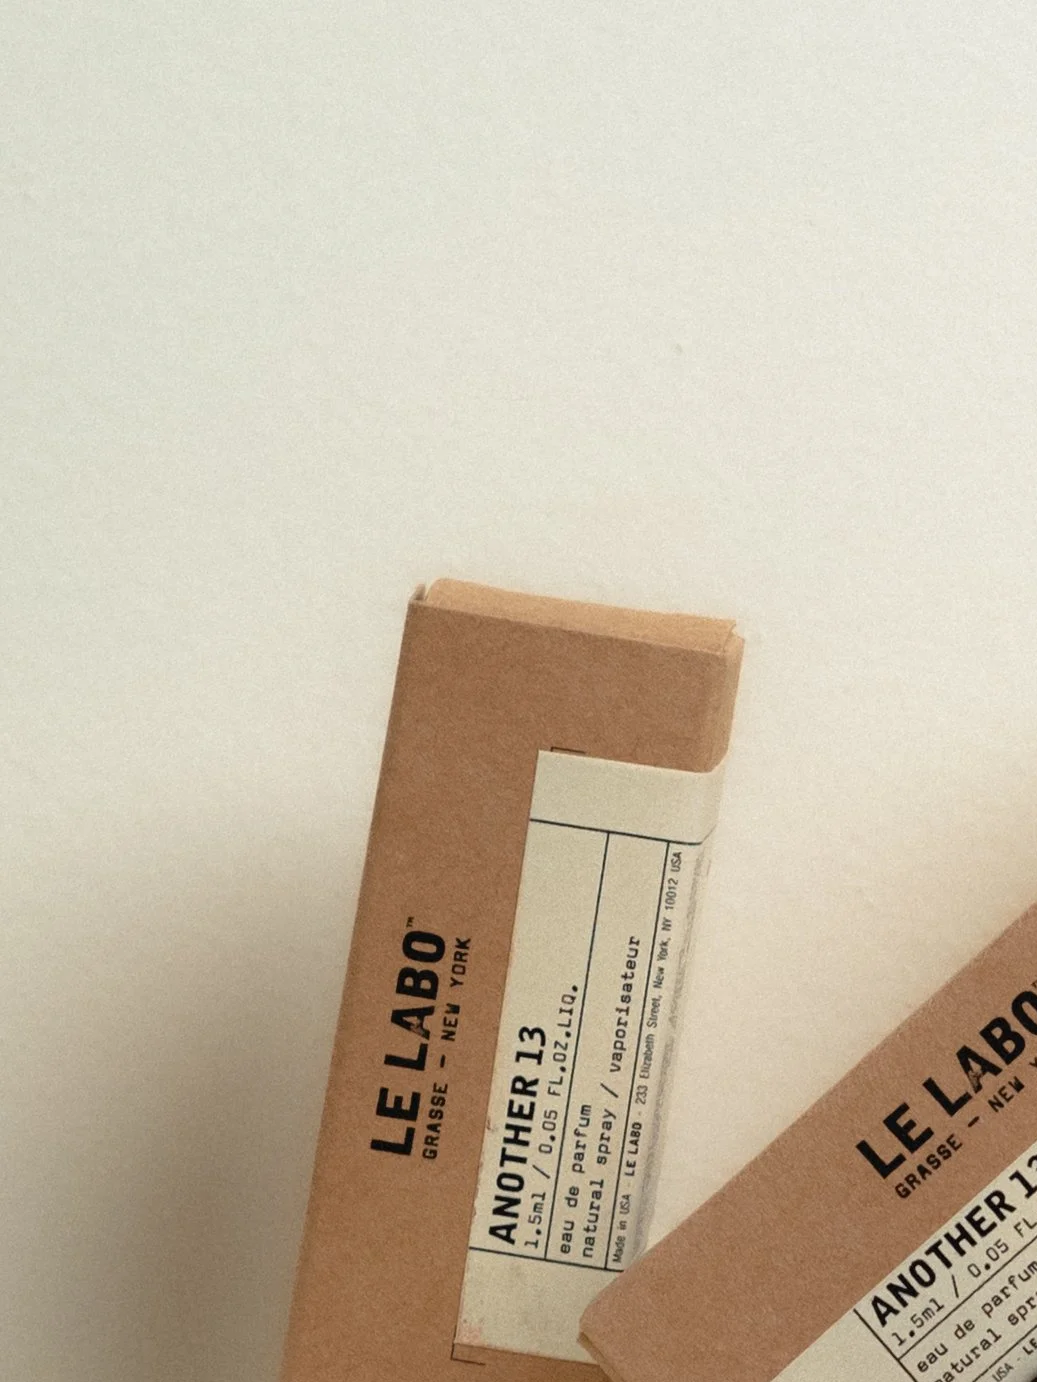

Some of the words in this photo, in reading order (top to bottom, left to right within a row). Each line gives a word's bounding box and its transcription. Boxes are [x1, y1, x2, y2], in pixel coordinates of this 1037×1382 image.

[669, 851, 682, 872] USA
[663, 876, 679, 910] 10012
[660, 916, 672, 932] NY
[448, 936, 471, 988] YORK
[652, 965, 665, 989] New
[440, 1002, 460, 1042] NEW
[638, 1032, 655, 1079] Elizabeth
[581, 1178, 604, 1258] natural
[595, 1107, 617, 1165] spray
[608, 935, 640, 1073] vaporisateur
[633, 1084, 648, 1105] 233
[369, 1086, 421, 1156] LE
[421, 1081, 448, 1160] GRASSE
[487, 1074, 539, 1245] ANOTHER
[514, 1025, 546, 1066] 13
[571, 1103, 592, 1174] parfum
[627, 1121, 642, 1155] LABO
[854, 1101, 934, 1180] LE
[894, 1132, 963, 1199] GRASSE
[987, 1075, 1025, 1113] NEW
[523, 1191, 546, 1249] 1.5ml
[537, 1109, 558, 1154] 0.05
[623, 1159, 636, 1177] LE
[563, 1185, 580, 1208] de
[618, 1193, 631, 1215] USA
[559, 1219, 575, 1254] eau
[616, 1219, 627, 1231] in
[611, 1235, 626, 1263] Made
[870, 1189, 1017, 1328] ANOTHER
[890, 1297, 945, 1346] 1.5ml
[966, 1238, 1009, 1278] 0.05
[916, 1342, 948, 1373] eau
[953, 1318, 975, 1340] de
[991, 1362, 1014, 1382] USA
